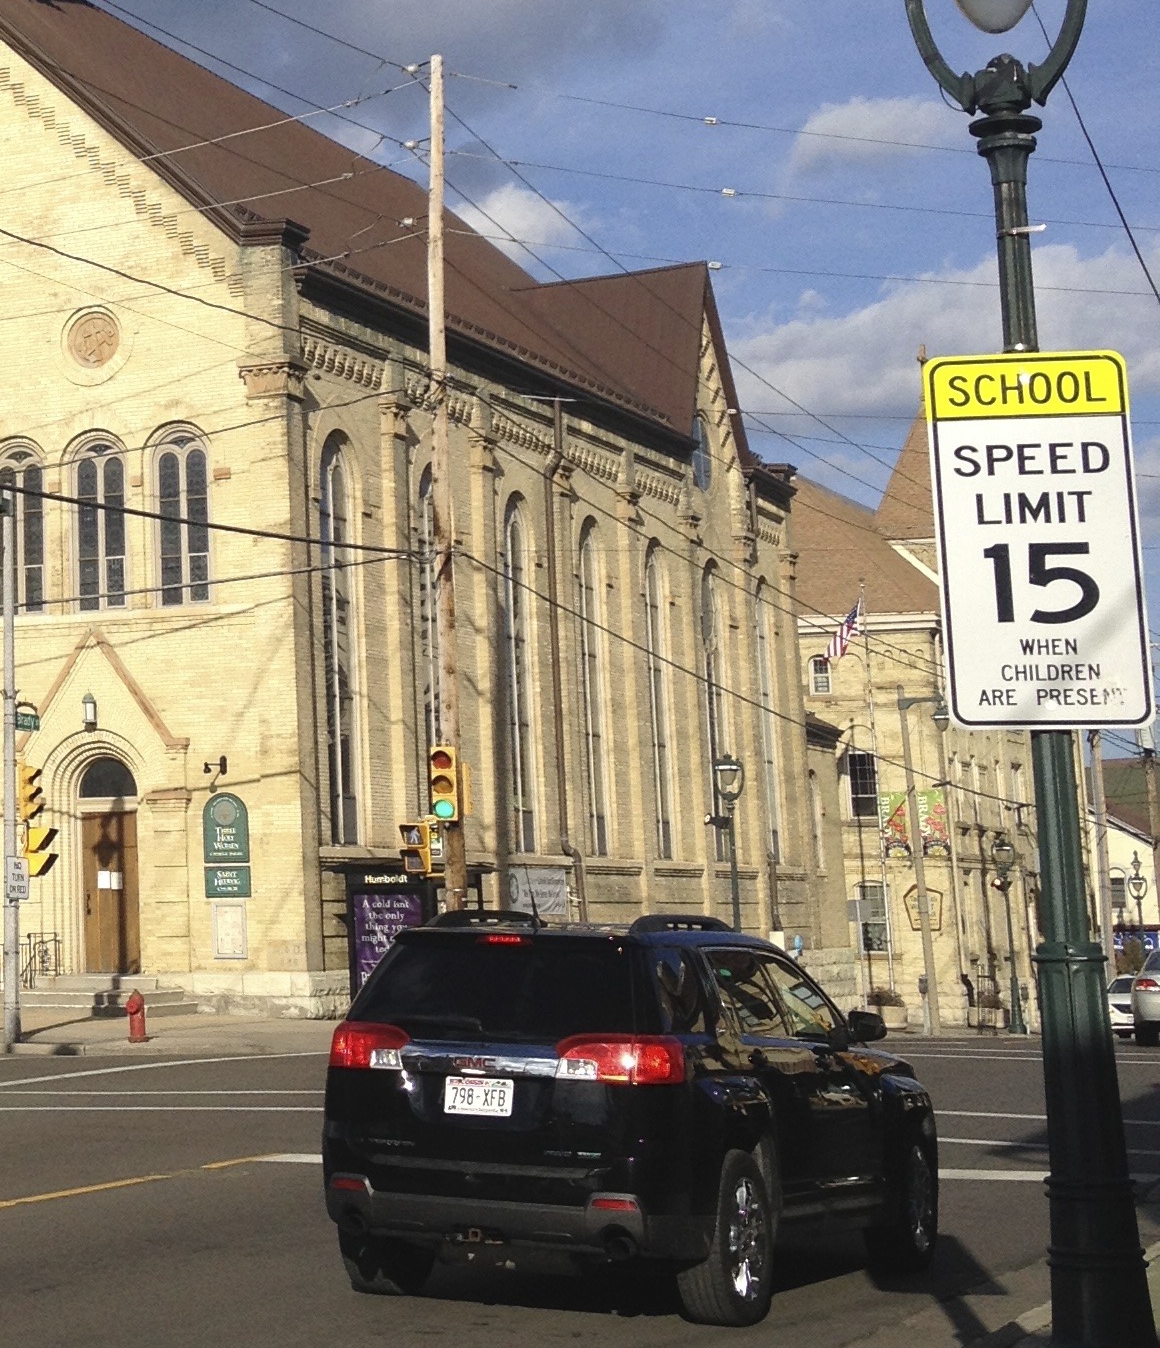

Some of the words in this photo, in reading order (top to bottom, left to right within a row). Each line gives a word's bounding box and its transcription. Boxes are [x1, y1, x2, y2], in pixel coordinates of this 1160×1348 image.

[948, 370, 1107, 407] SCHOOL
[953, 441, 1110, 477] SPEED
[976, 491, 1092, 525] LIMIT
[983, 541, 1100, 624] 15
[1020, 638, 1077, 655] WHEN
[1001, 663, 1100, 682] CHILDREN
[979, 689, 1017, 706] ARE
[1037, 687, 1127, 706] PRESEN
[14, 861, 22, 870] NO
[12, 873, 24, 881] TURN
[364, 874, 408, 884] Humboldt
[17, 885, 26, 893] RED
[362, 899, 369, 908] A
[372, 899, 390, 908] cold
[368, 912, 383, 920] the
[385, 911, 404, 921] only
[365, 922, 389, 932] thing
[361, 935, 387, 944] might
[453, 1056, 496, 1068] GMC
[452, 1087, 506, 1107] 798-XFB
